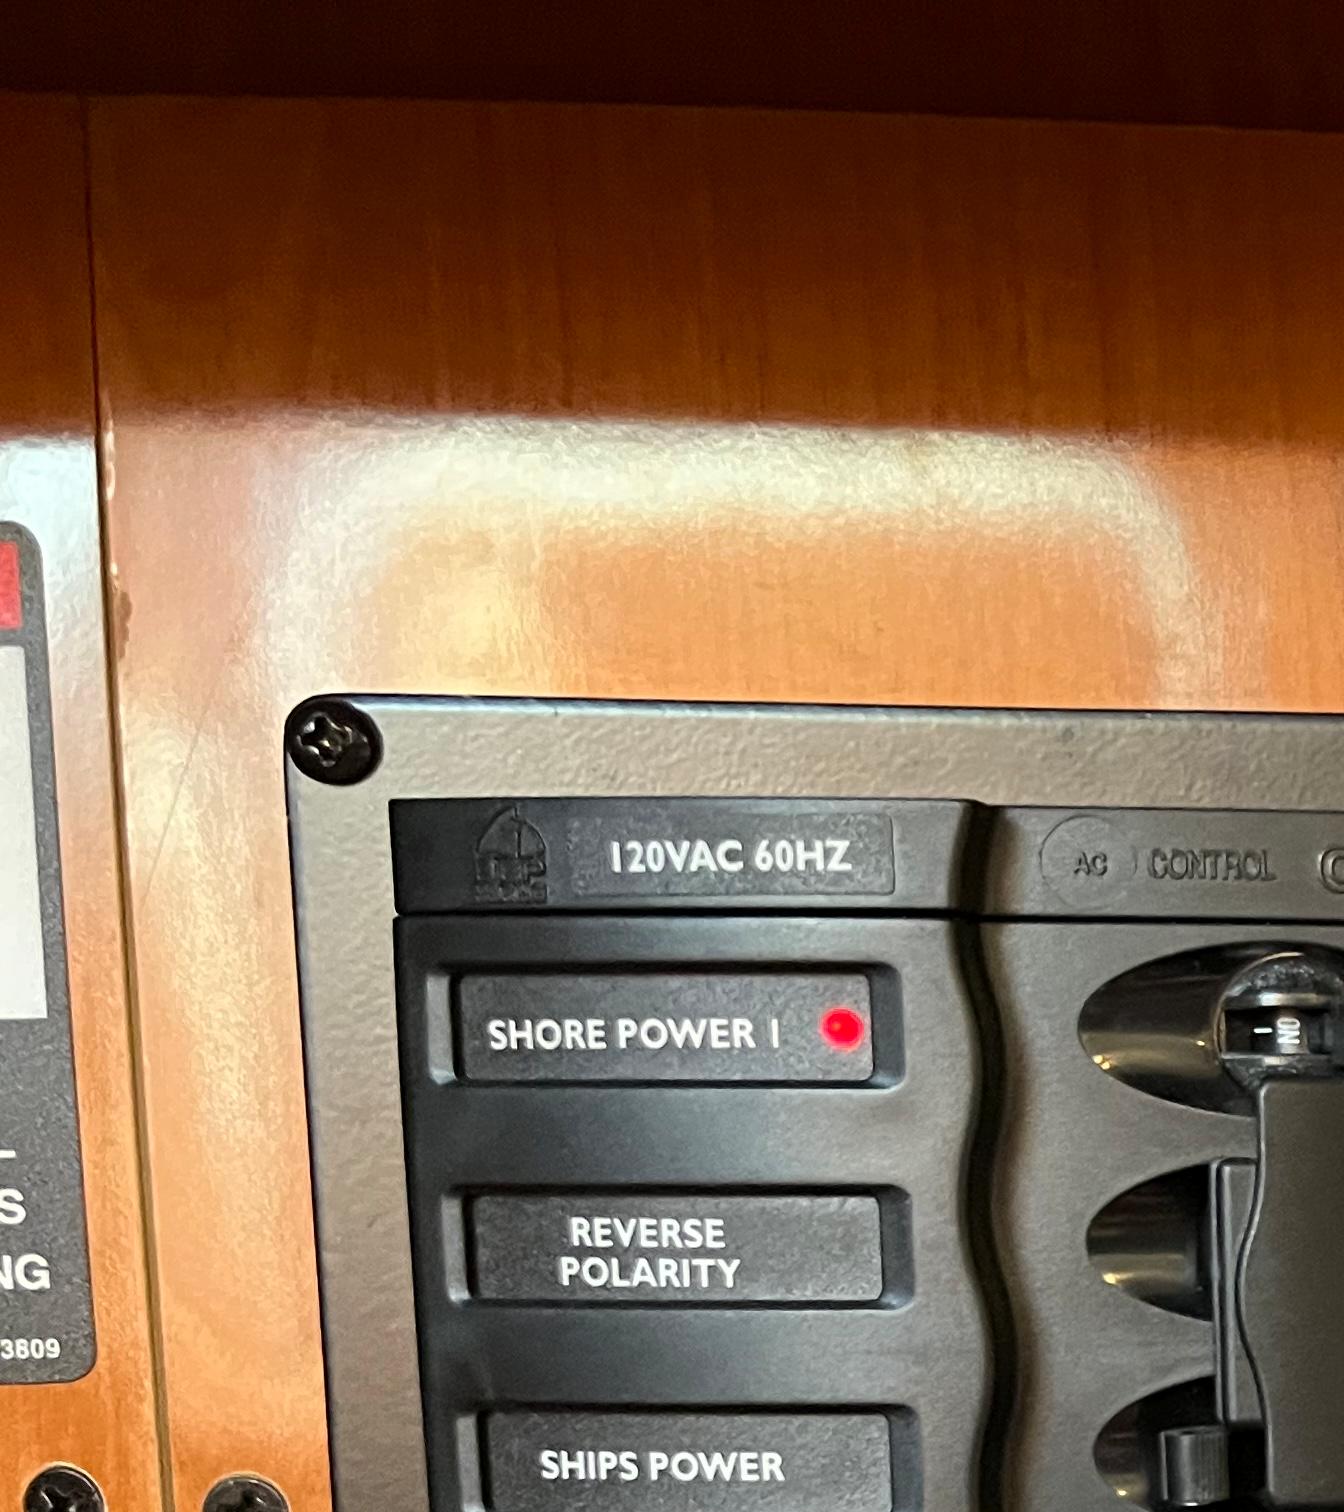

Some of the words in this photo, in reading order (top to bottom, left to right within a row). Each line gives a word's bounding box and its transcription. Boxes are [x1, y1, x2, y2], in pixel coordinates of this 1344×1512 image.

[611, 839, 744, 873] 120VAC
[754, 837, 853, 874] 60HZ
[1072, 850, 1109, 878] AC
[1146, 847, 1277, 882] CONTROL
[487, 1018, 607, 1050] SHORE
[617, 1017, 757, 1049] POWER
[570, 1216, 726, 1249] REVERSE
[560, 1256, 741, 1289] POLARITY
[540, 1449, 639, 1481] SHIPS
[648, 1451, 786, 1482] POWER
